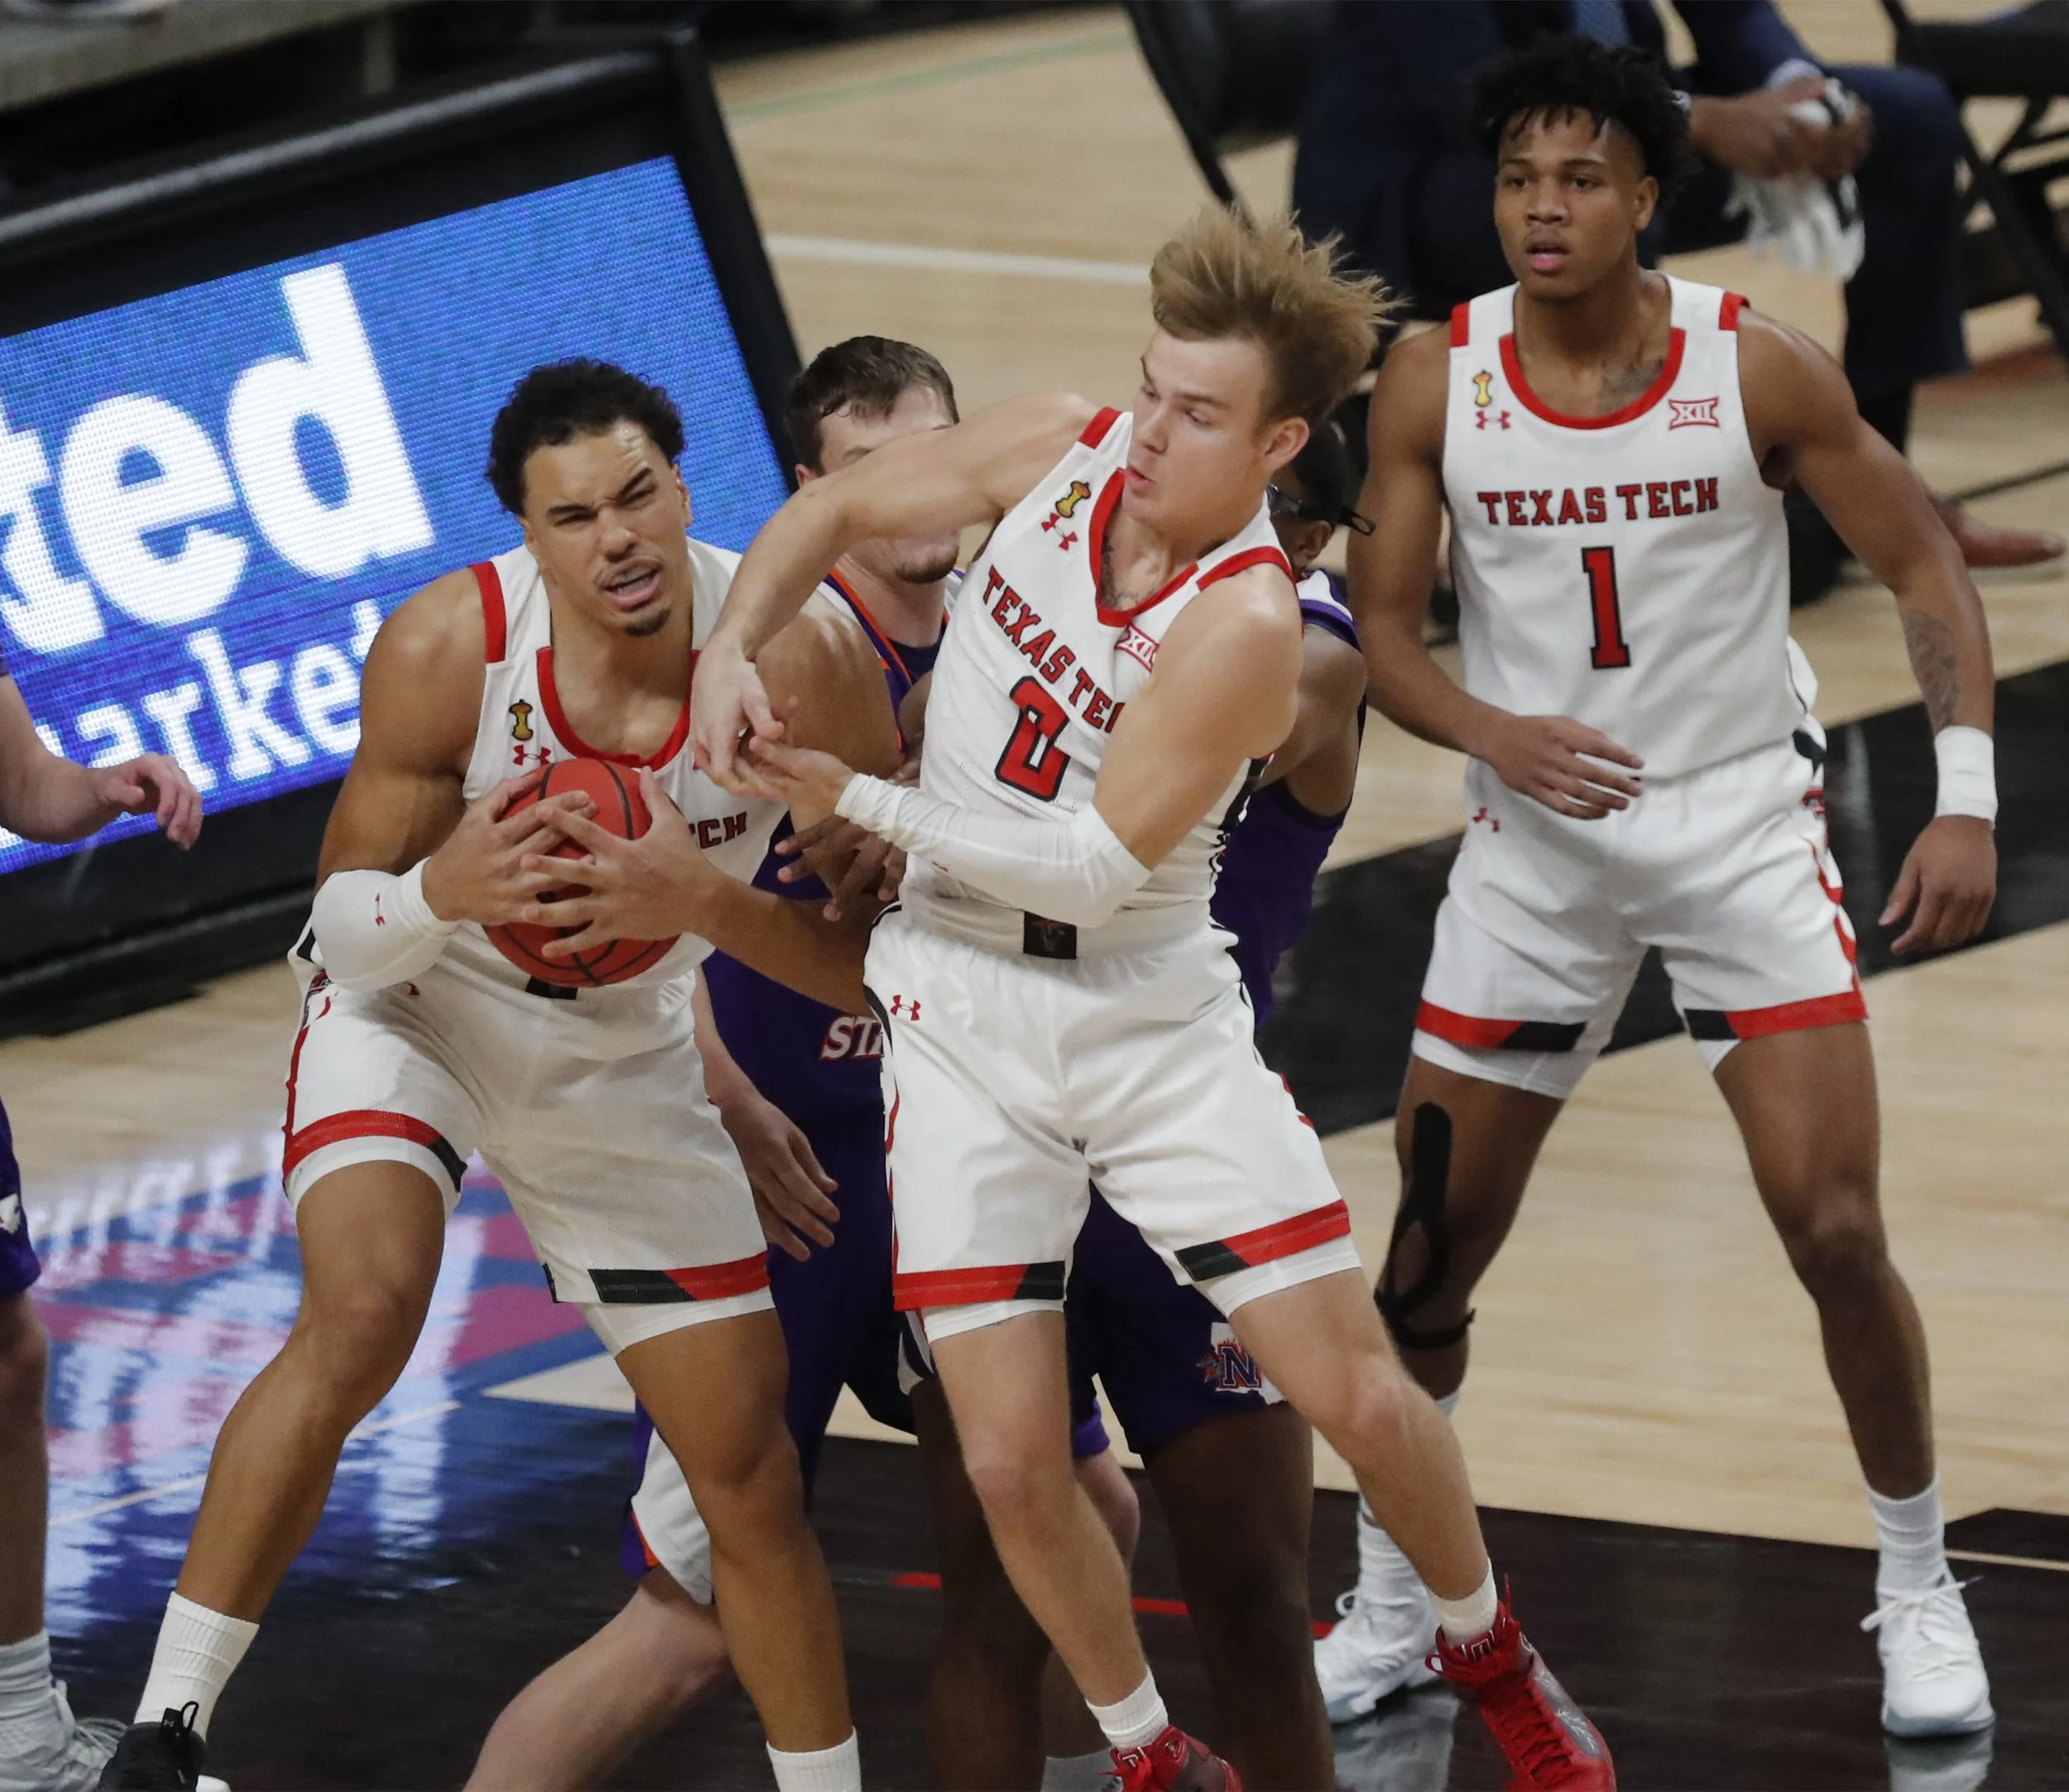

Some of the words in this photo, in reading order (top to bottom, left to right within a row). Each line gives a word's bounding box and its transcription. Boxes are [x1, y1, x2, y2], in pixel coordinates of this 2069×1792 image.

[1477, 487, 1607, 526] TEXAS
[1615, 477, 1719, 521] TECH
[980, 564, 1077, 685] TEXAS
[1581, 545, 1631, 670] 1
[33, 598, 384, 819] arke
[994, 675, 1071, 802] 0
[689, 811, 747, 850] CH
[1220, 1345, 1260, 1388] N
